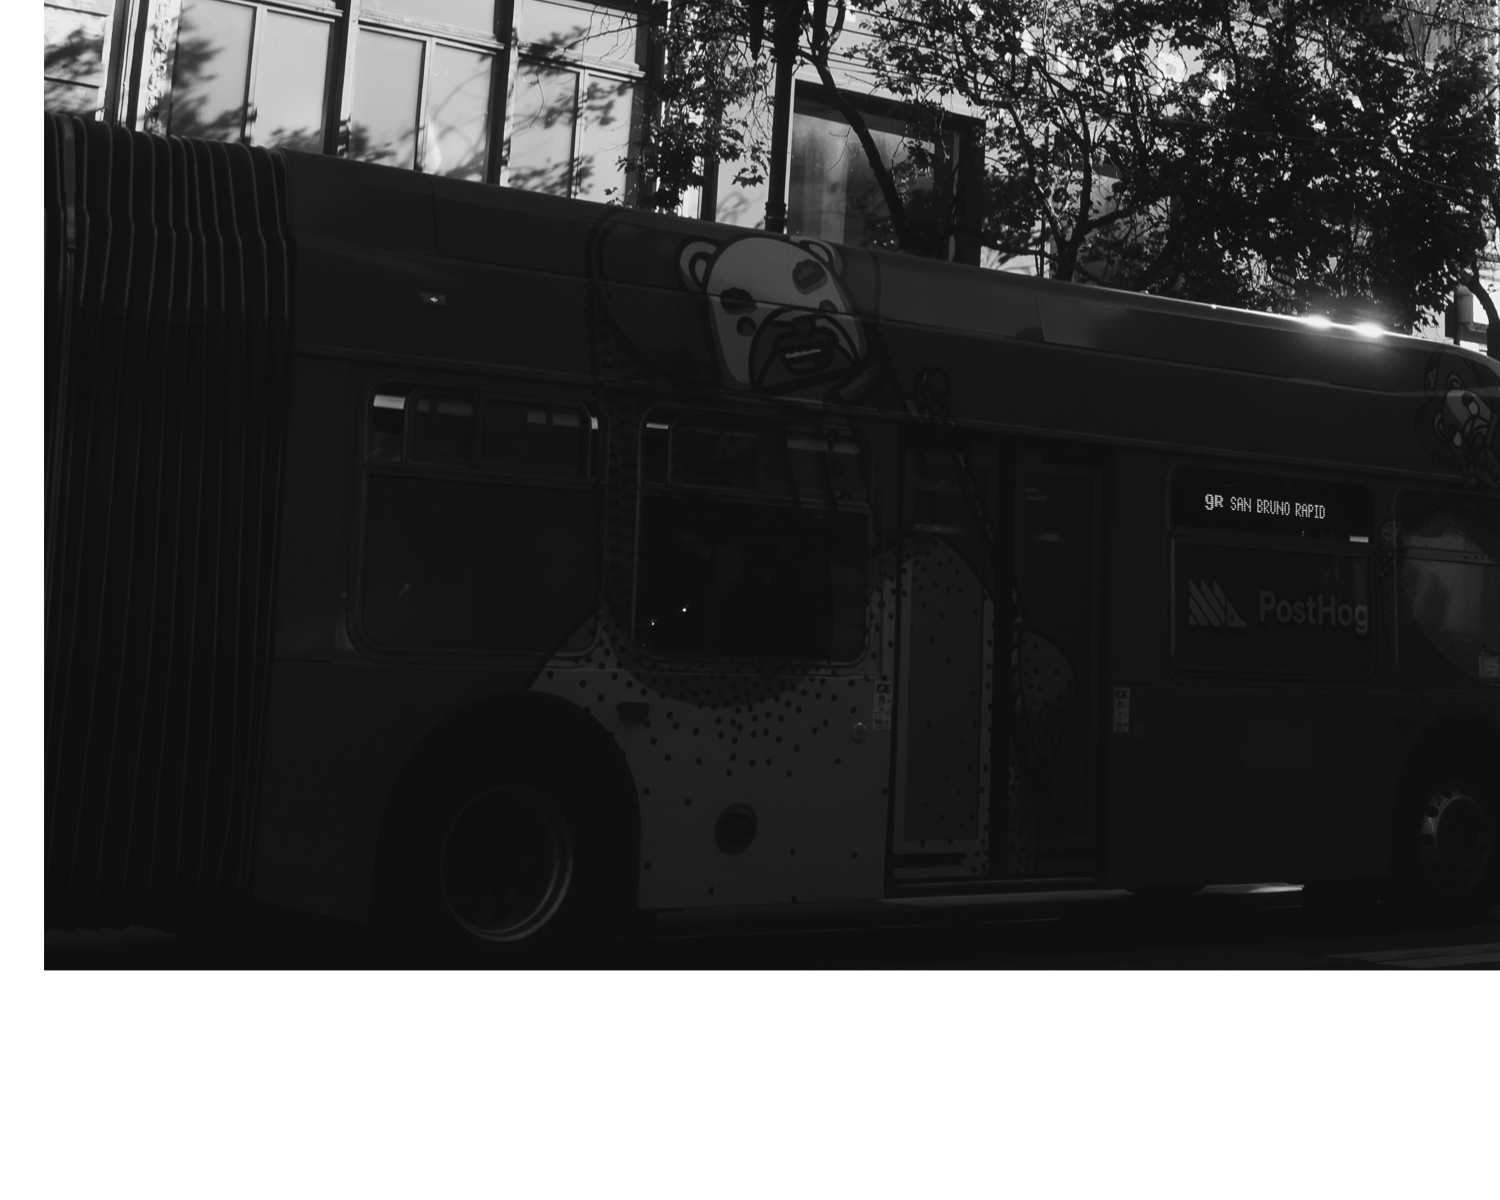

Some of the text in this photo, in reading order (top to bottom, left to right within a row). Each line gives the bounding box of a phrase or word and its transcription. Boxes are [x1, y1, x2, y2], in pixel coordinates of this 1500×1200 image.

[1204, 493, 1326, 520] 9R SAN BRUNO RAPID
[1258, 589, 1370, 636] PostHog
